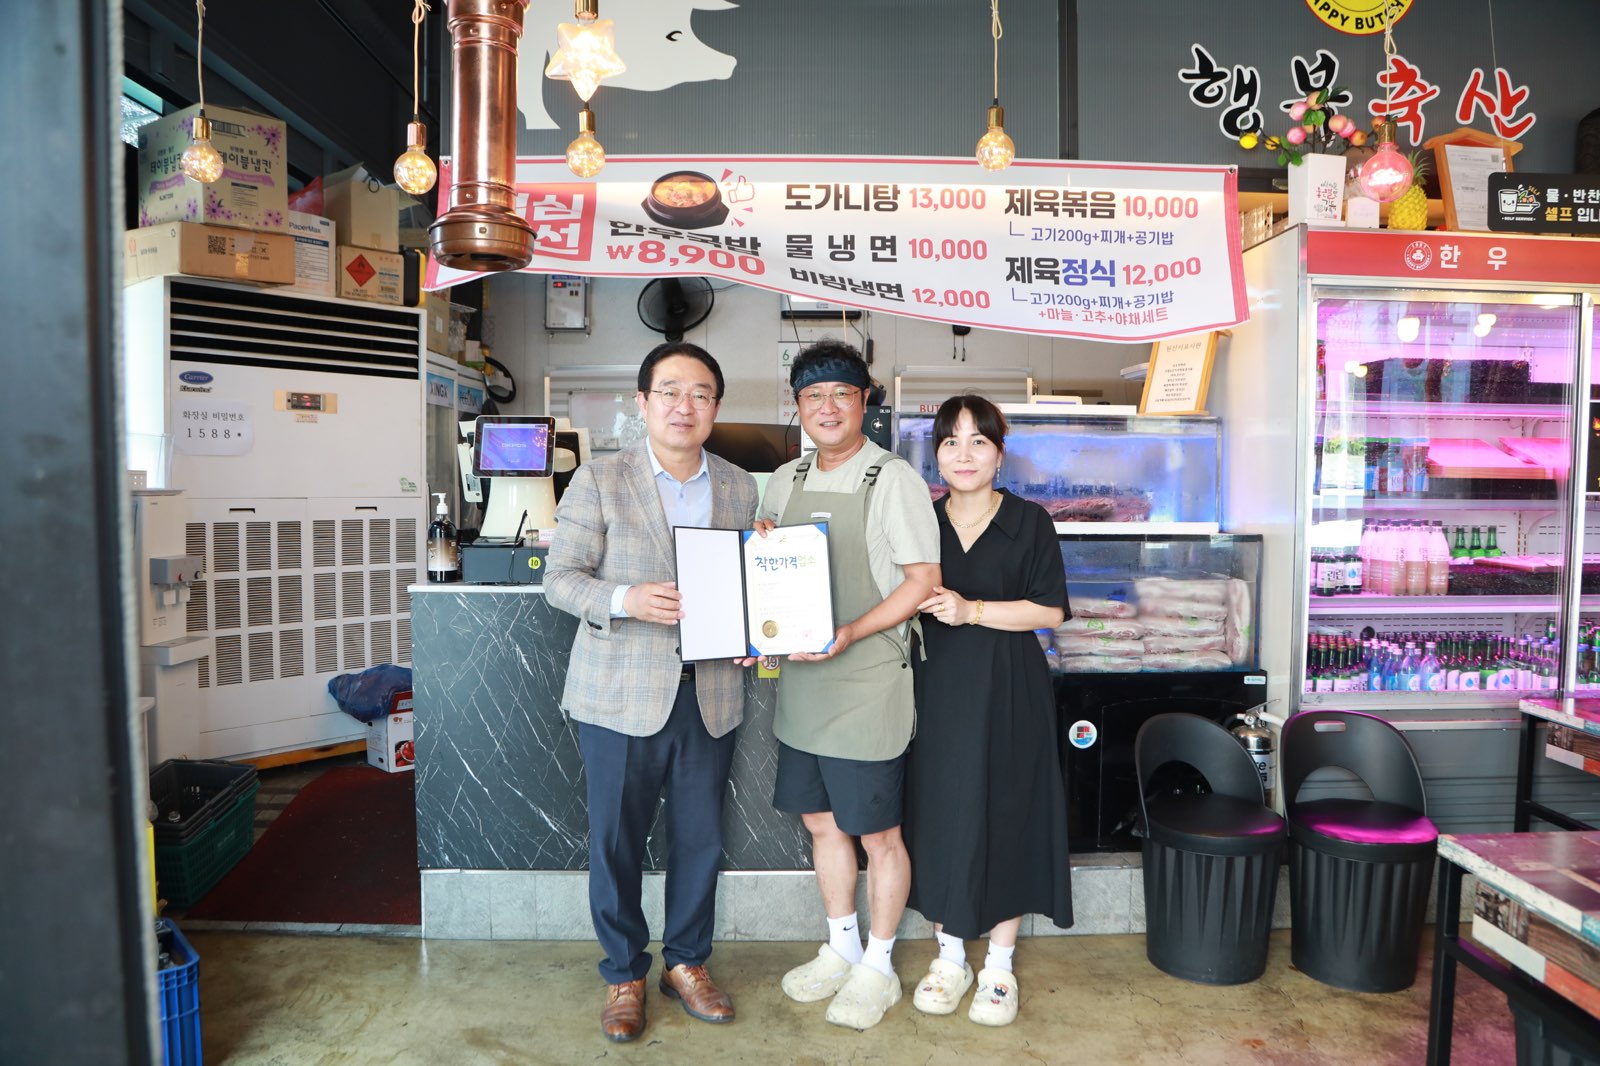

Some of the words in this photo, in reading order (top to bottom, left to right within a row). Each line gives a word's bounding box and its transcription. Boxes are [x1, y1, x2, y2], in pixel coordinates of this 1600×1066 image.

[1313, 0, 1349, 26] PPY
[785, 183, 901, 212] 도가니탕
[908, 187, 987, 212] 13,000
[1004, 188, 1116, 219] 제육볶음
[1123, 196, 1199, 220] 10,000
[1545, 207, 1573, 222] 셀프
[609, 220, 761, 256] 한우국밥
[908, 238, 988, 262] 10,000
[1005, 257, 1116, 287] 제육정식
[1122, 257, 1201, 287] 12,000
[790, 267, 905, 302] 비빔냉면
[911, 288, 991, 309] 12,000
[782, 349, 789, 361] 6
[182, 410, 208, 420] 화장실
[212, 411, 245, 422] 비밀번호
[530, 559, 539, 567] 10
[755, 555, 816, 572] 착한가격업소
